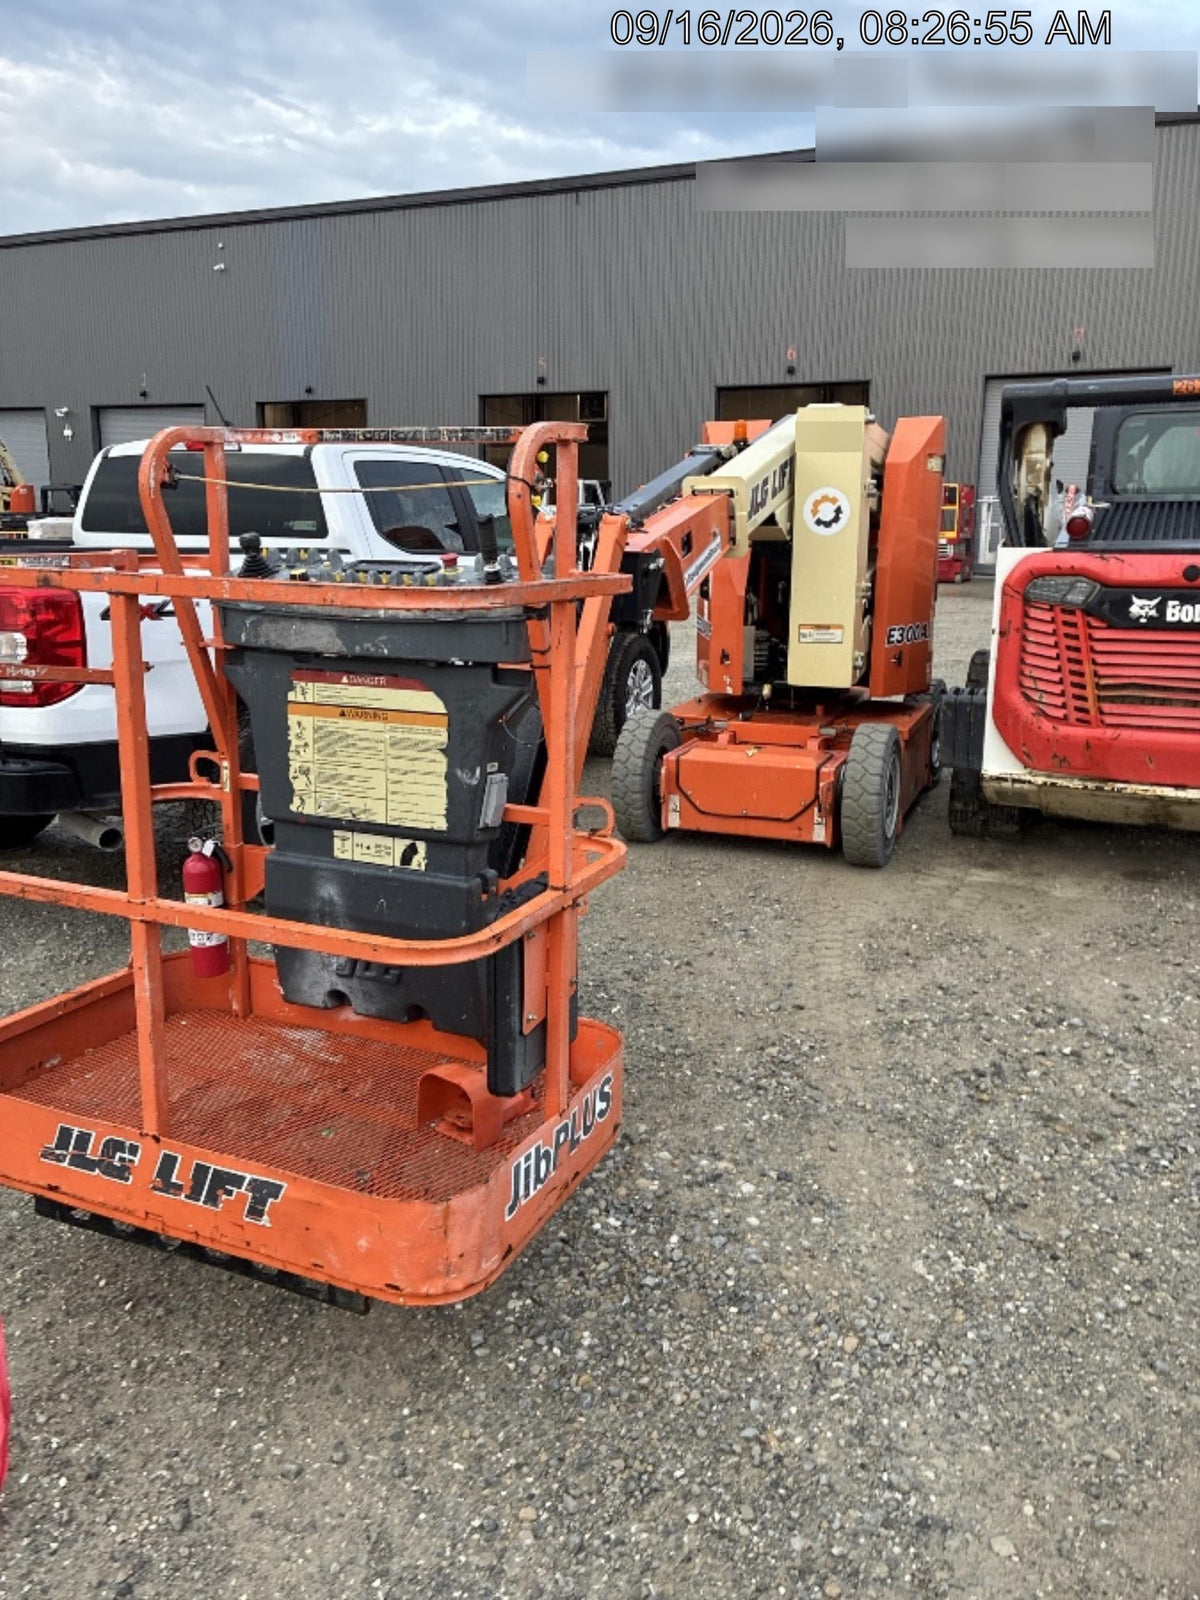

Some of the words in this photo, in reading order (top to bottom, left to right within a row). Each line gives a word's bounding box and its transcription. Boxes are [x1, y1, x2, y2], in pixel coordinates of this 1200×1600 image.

[349, 675, 387, 686] DANGER
[346, 709, 389, 721] WARNING
[39, 1123, 141, 1184] JLG
[150, 1150, 288, 1227] LIFT
